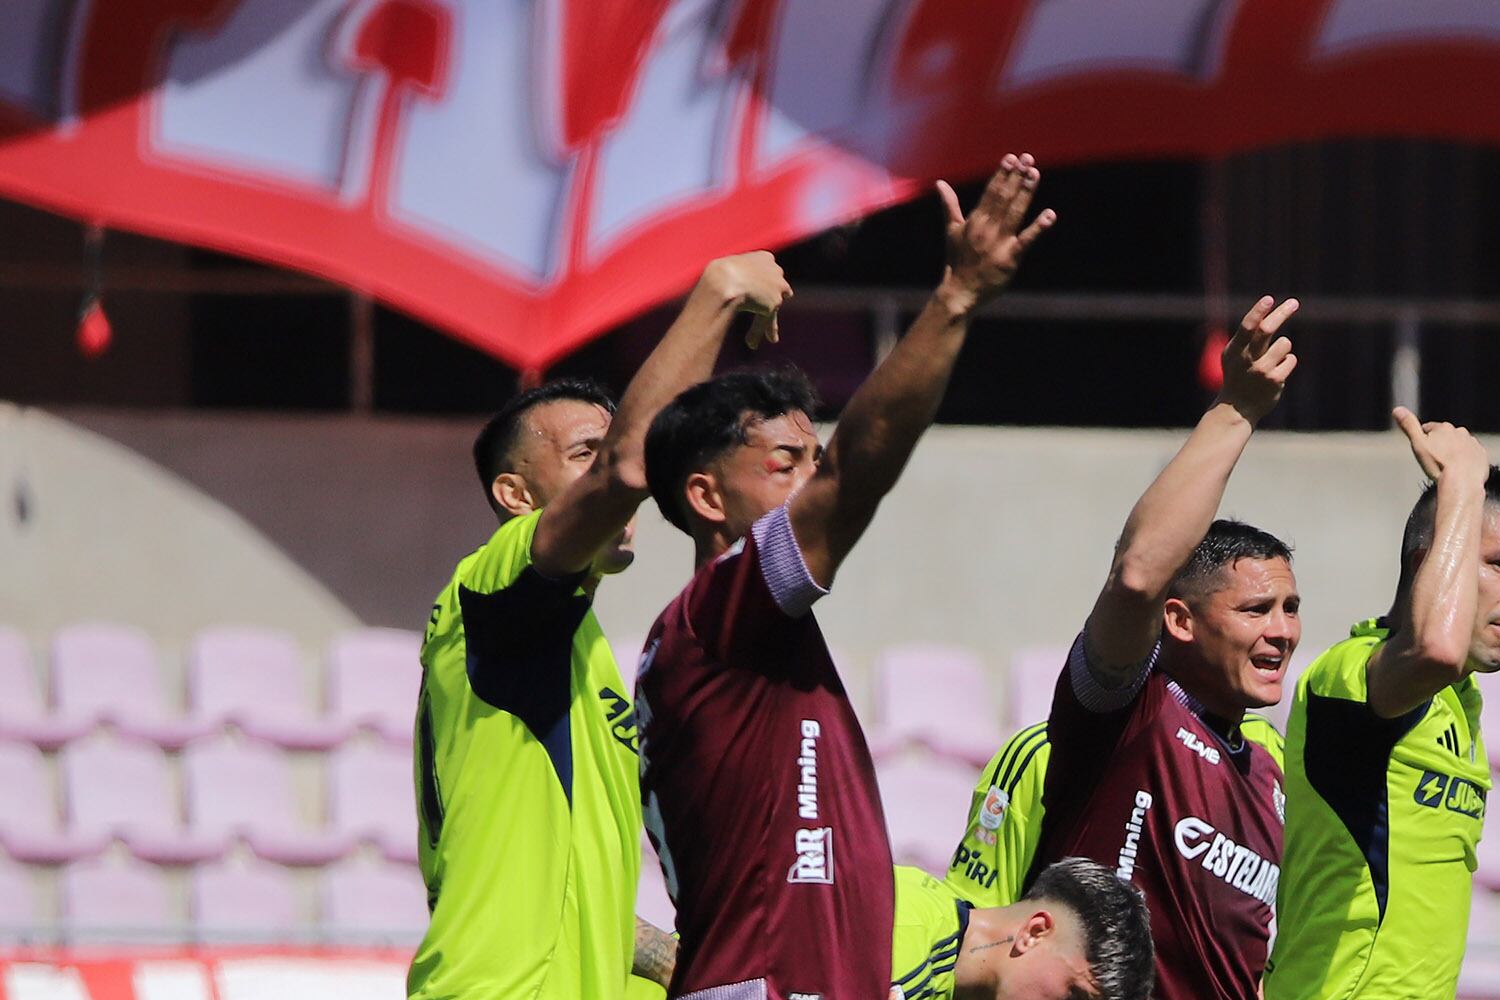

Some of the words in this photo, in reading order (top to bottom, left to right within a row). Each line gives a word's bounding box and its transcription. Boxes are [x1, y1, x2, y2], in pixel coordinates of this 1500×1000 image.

[796, 719, 821, 819] Mining
[1176, 727, 1221, 765] FIUME
[1116, 790, 1153, 881] Mining
